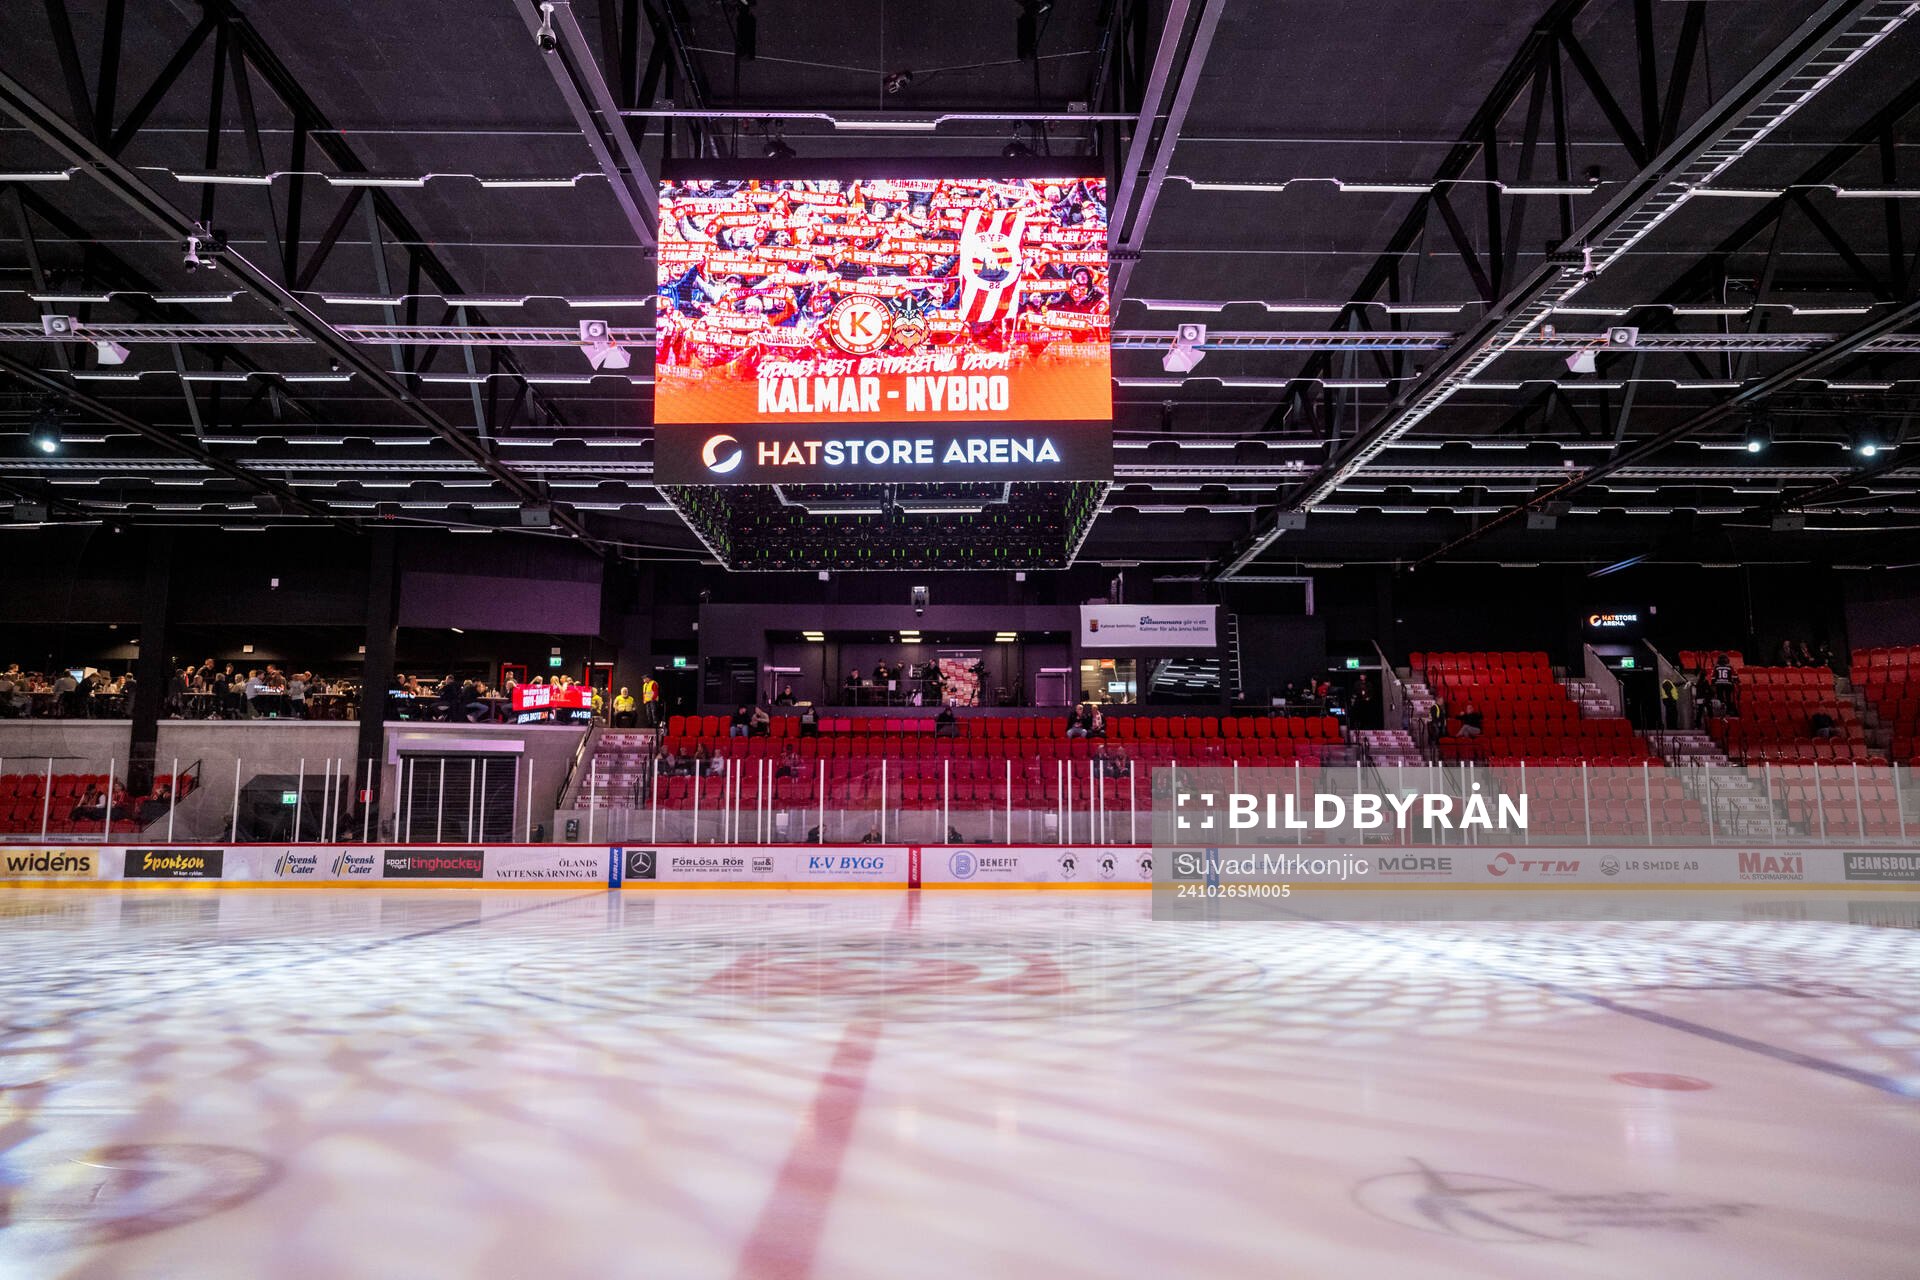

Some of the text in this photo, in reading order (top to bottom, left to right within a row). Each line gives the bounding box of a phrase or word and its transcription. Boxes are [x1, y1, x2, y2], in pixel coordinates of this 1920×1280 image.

[850, 311, 873, 337] K
[757, 376, 881, 413] KALMAR
[905, 375, 1009, 412] NYBRO
[757, 437, 1061, 466] HATSTORE ARENA
[1718, 669, 1728, 679] 16
[7, 851, 90, 872] widéns
[142, 852, 205, 871] Sportson
[287, 854, 318, 864] Svensk
[344, 854, 375, 864] Svensk
[386, 858, 407, 866] sport
[411, 855, 481, 871] tinghockey
[559, 858, 598, 867] ÖLANDS
[672, 857, 744, 866] FÖRLÖSA RÖR
[765, 858, 772, 866] &
[809, 857, 885, 869] K-V BYGG
[979, 858, 1018, 867] BENEFIT
[1378, 854, 1452, 870] MÖRE
[290, 864, 315, 874] Cater
[348, 864, 372, 874] Cater
[1519, 860, 1581, 872] TTM
[1625, 861, 1699, 870] LR SMIDE AB
[496, 867, 598, 878] VATTENSKÄRNING AB
